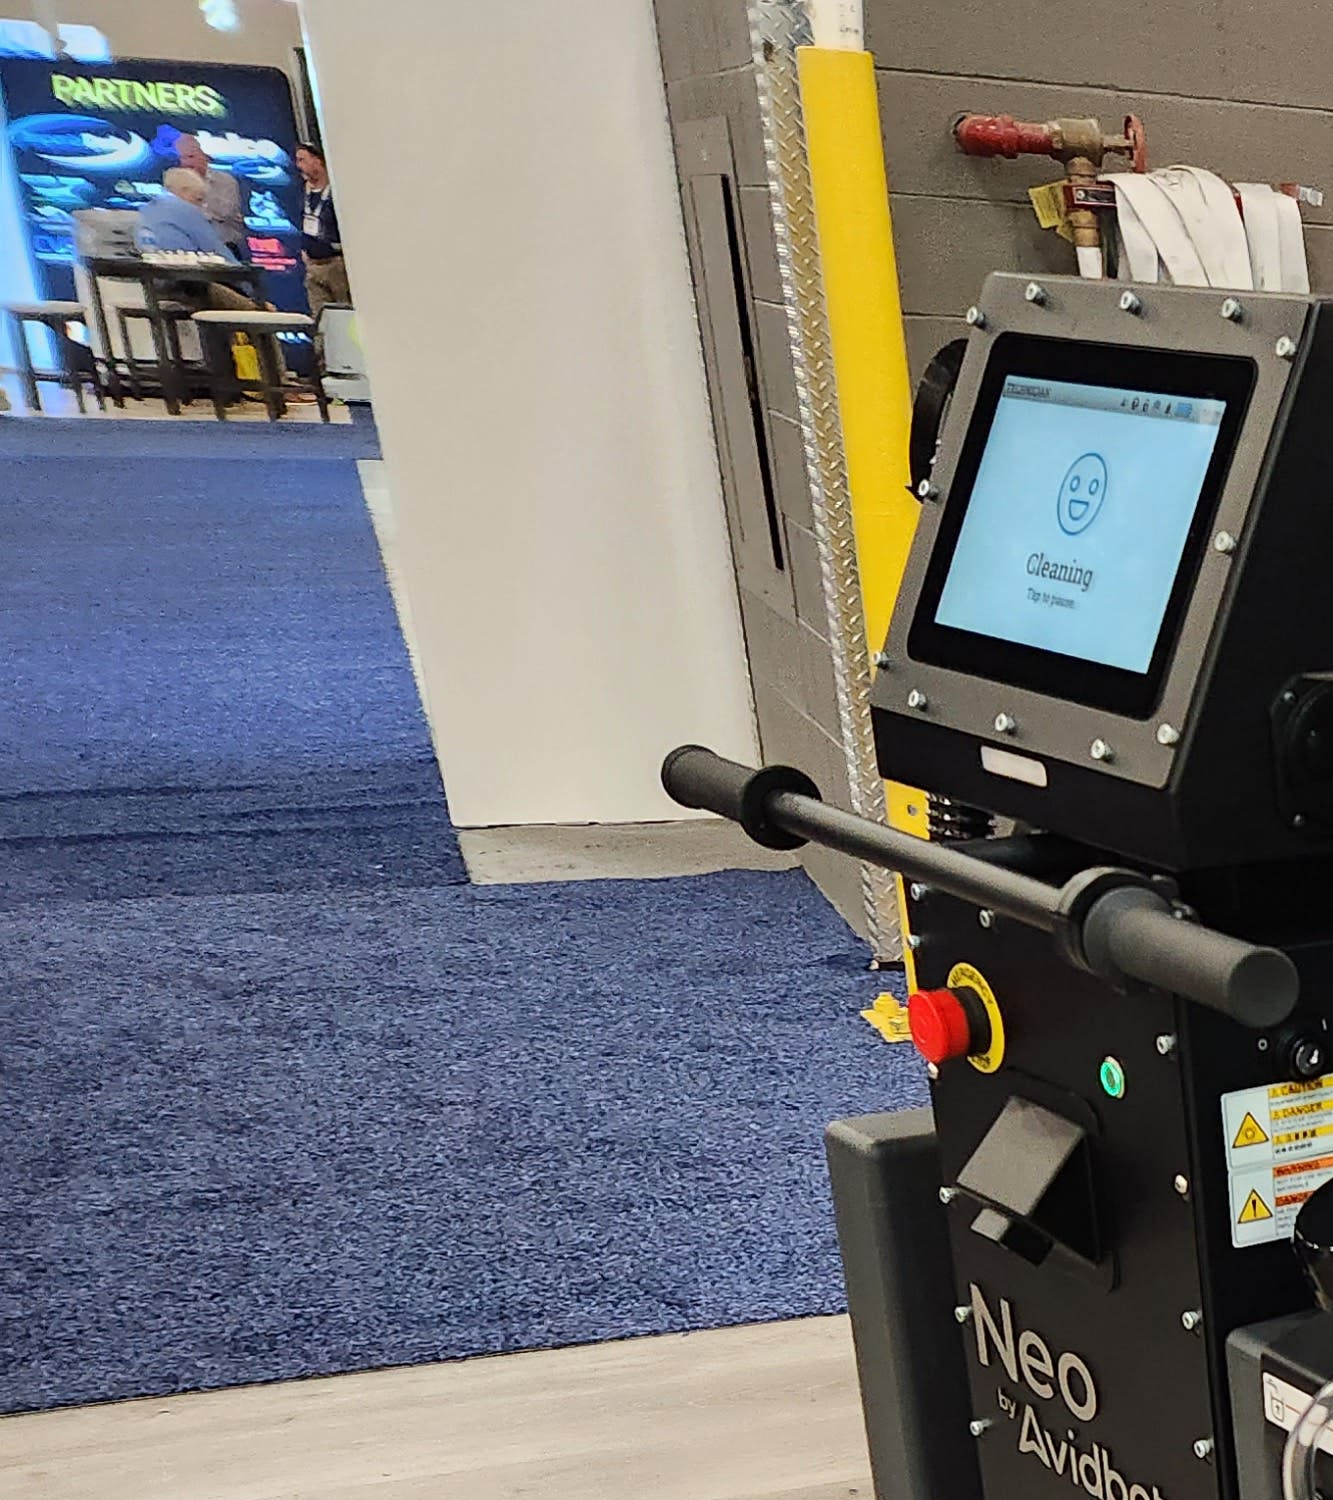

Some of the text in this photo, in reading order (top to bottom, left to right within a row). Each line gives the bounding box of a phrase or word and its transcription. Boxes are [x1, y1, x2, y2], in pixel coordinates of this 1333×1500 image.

[52, 73, 228, 118] PARTNERS
[1026, 552, 1094, 592] Cleaning
[1280, 1079, 1323, 1097] CAUTION
[1282, 1102, 1323, 1119] DANGER
[970, 1281, 1097, 1422] Neo
[998, 1386, 1017, 1420] by
